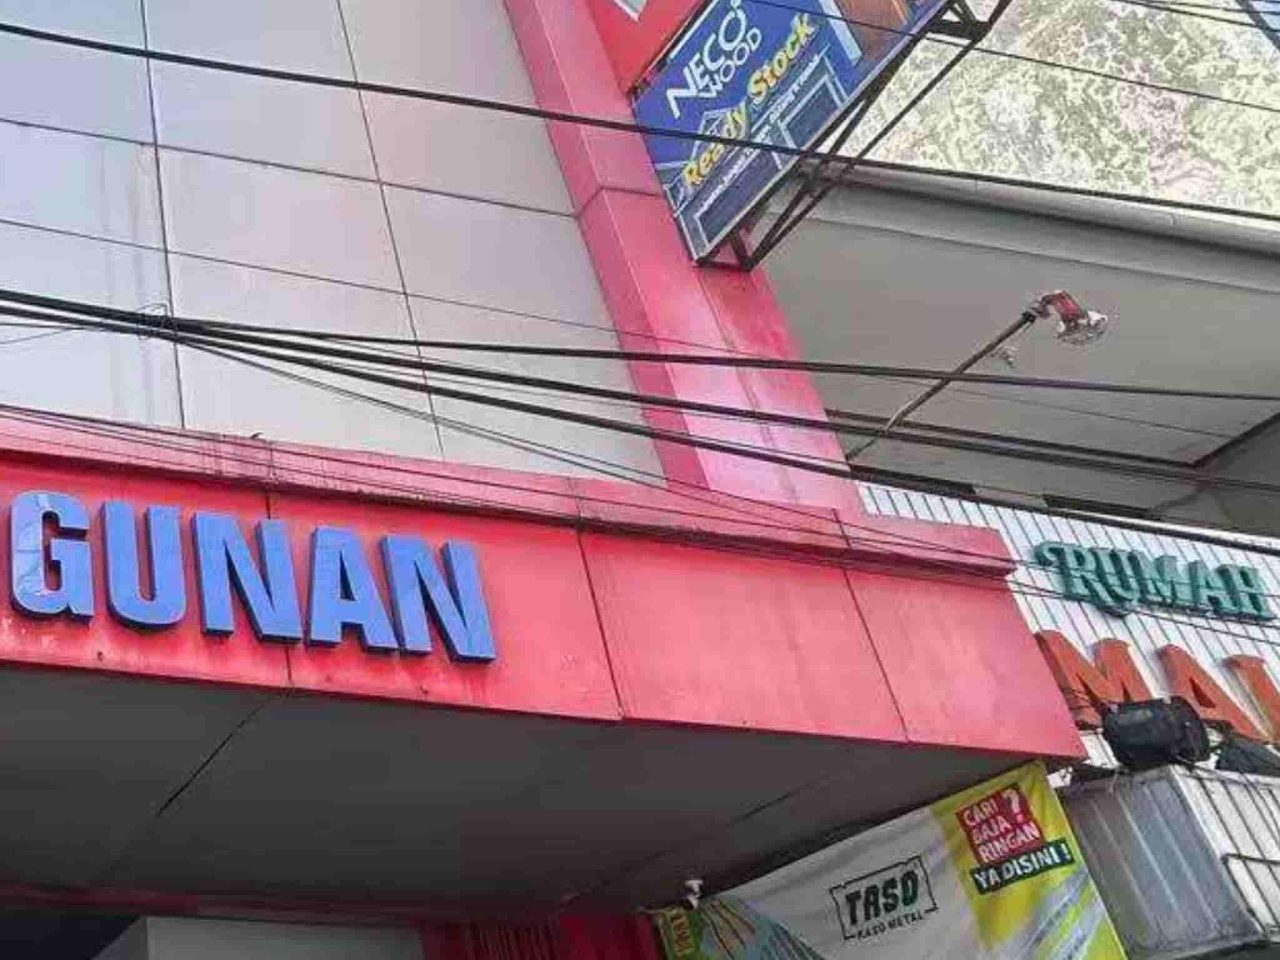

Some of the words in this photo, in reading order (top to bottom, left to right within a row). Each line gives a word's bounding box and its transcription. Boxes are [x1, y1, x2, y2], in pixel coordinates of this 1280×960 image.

[666, 9, 747, 119] NECO
[699, 27, 762, 100] WOOD
[681, 102, 748, 188] Ready
[746, 12, 816, 105] Stock
[1032, 541, 1276, 620] RUMAH
[964, 798, 999, 827] CARI
[978, 822, 1040, 863] RINGAN
[846, 870, 919, 926] TASO
[974, 869, 1002, 889] YA
[1001, 846, 1060, 880] DISINI
